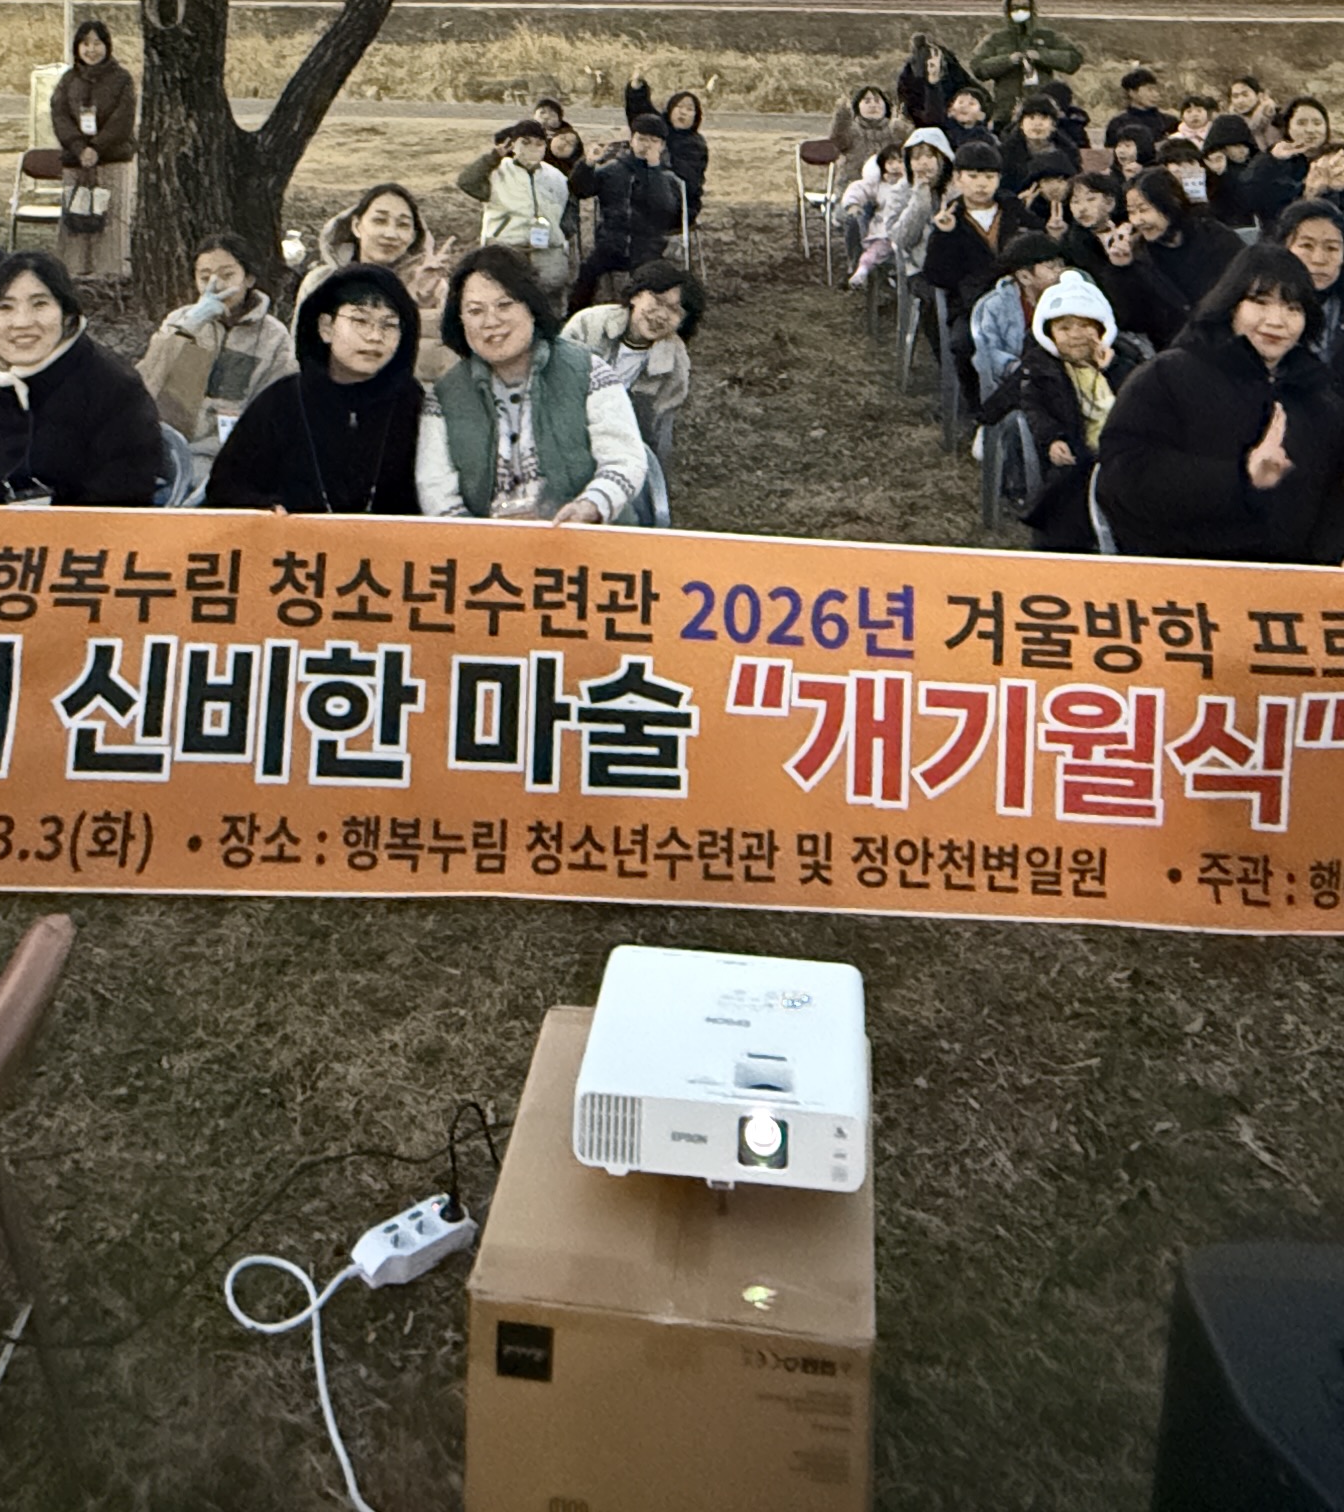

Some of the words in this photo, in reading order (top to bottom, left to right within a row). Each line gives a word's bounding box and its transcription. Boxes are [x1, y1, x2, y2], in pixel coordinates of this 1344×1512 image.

[269, 551, 659, 643] 청소년수련관
[679, 579, 915, 659] 2026년
[944, 590, 1220, 680] 겨울방학
[52, 634, 426, 786] 신비한
[447, 650, 699, 798] 마술
[341, 815, 510, 875] 행복누림
[526, 819, 779, 884] 청소년수련관
[796, 832, 834, 886] 및
[850, 836, 1109, 900] 정안천변일원
